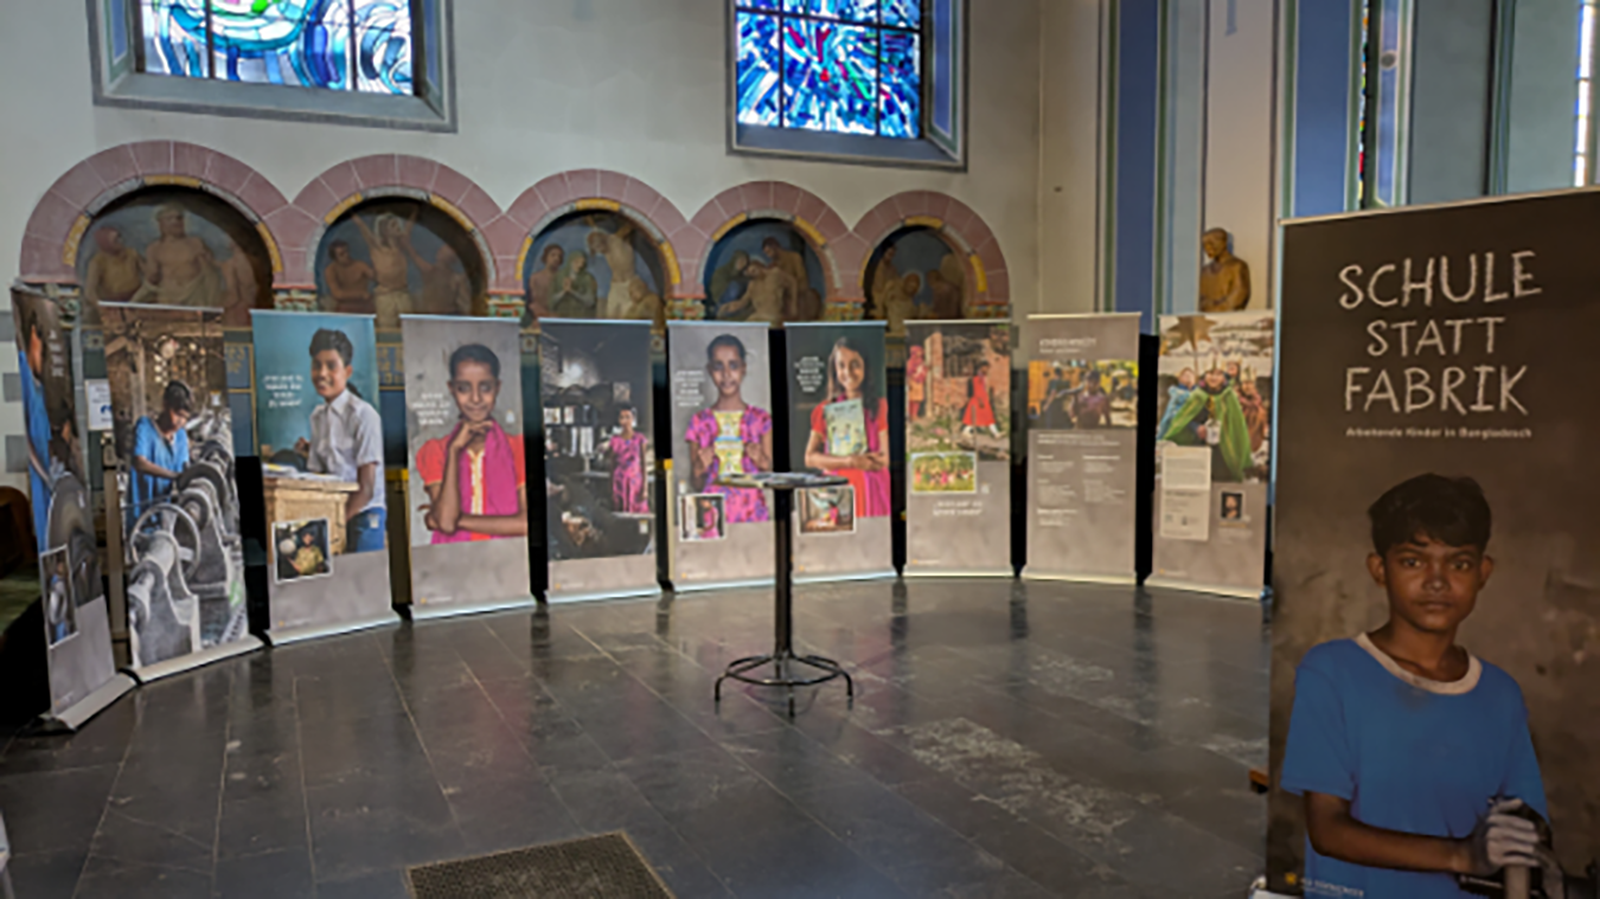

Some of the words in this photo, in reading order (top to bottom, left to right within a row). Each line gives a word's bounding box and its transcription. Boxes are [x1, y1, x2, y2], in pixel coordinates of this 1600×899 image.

[1339, 250, 1542, 309] SCHULE
[1366, 317, 1505, 357] STATT
[1345, 364, 1528, 415] FABRIK
[1444, 427, 1456, 437] in
